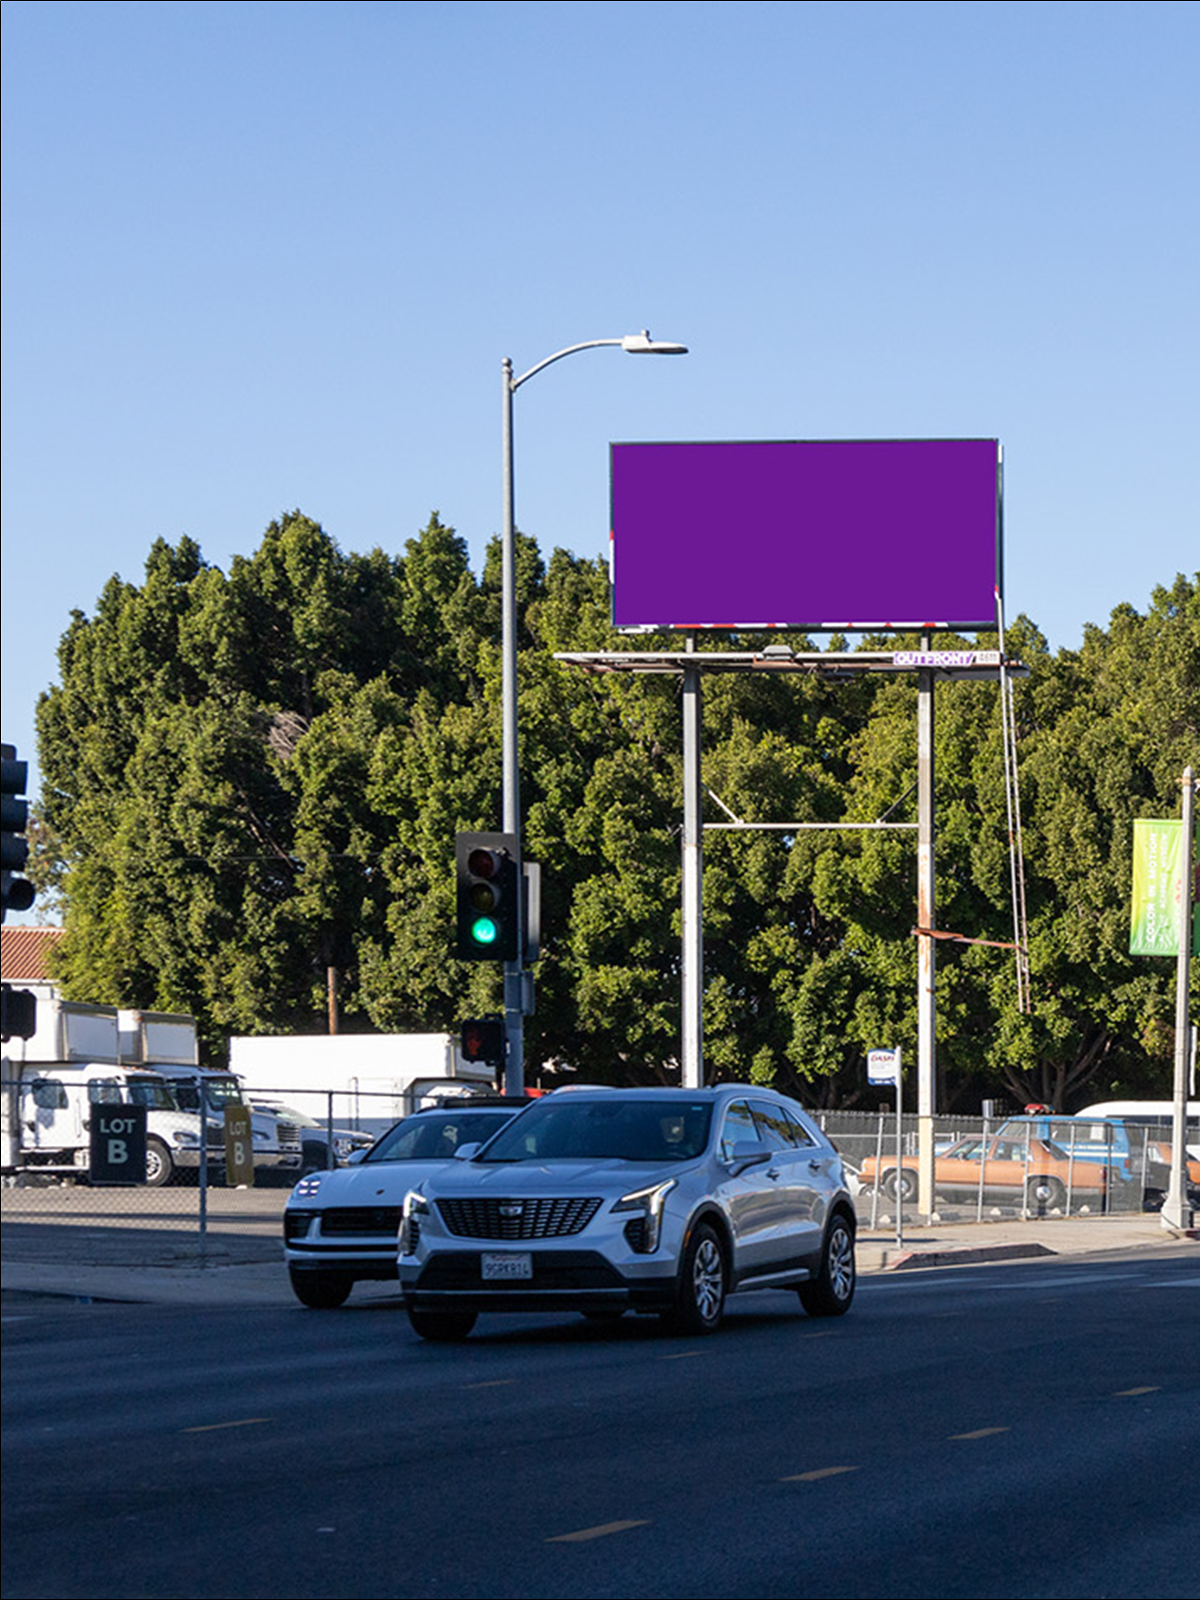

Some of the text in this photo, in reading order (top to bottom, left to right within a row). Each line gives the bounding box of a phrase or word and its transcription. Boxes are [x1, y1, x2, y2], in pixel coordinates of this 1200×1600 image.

[1146, 832, 1158, 943] COLOR IN MOTION
[100, 1118, 136, 1135] LOT
[229, 1121, 246, 1136] LOT
[107, 1139, 129, 1165] B
[234, 1142, 245, 1165] B
